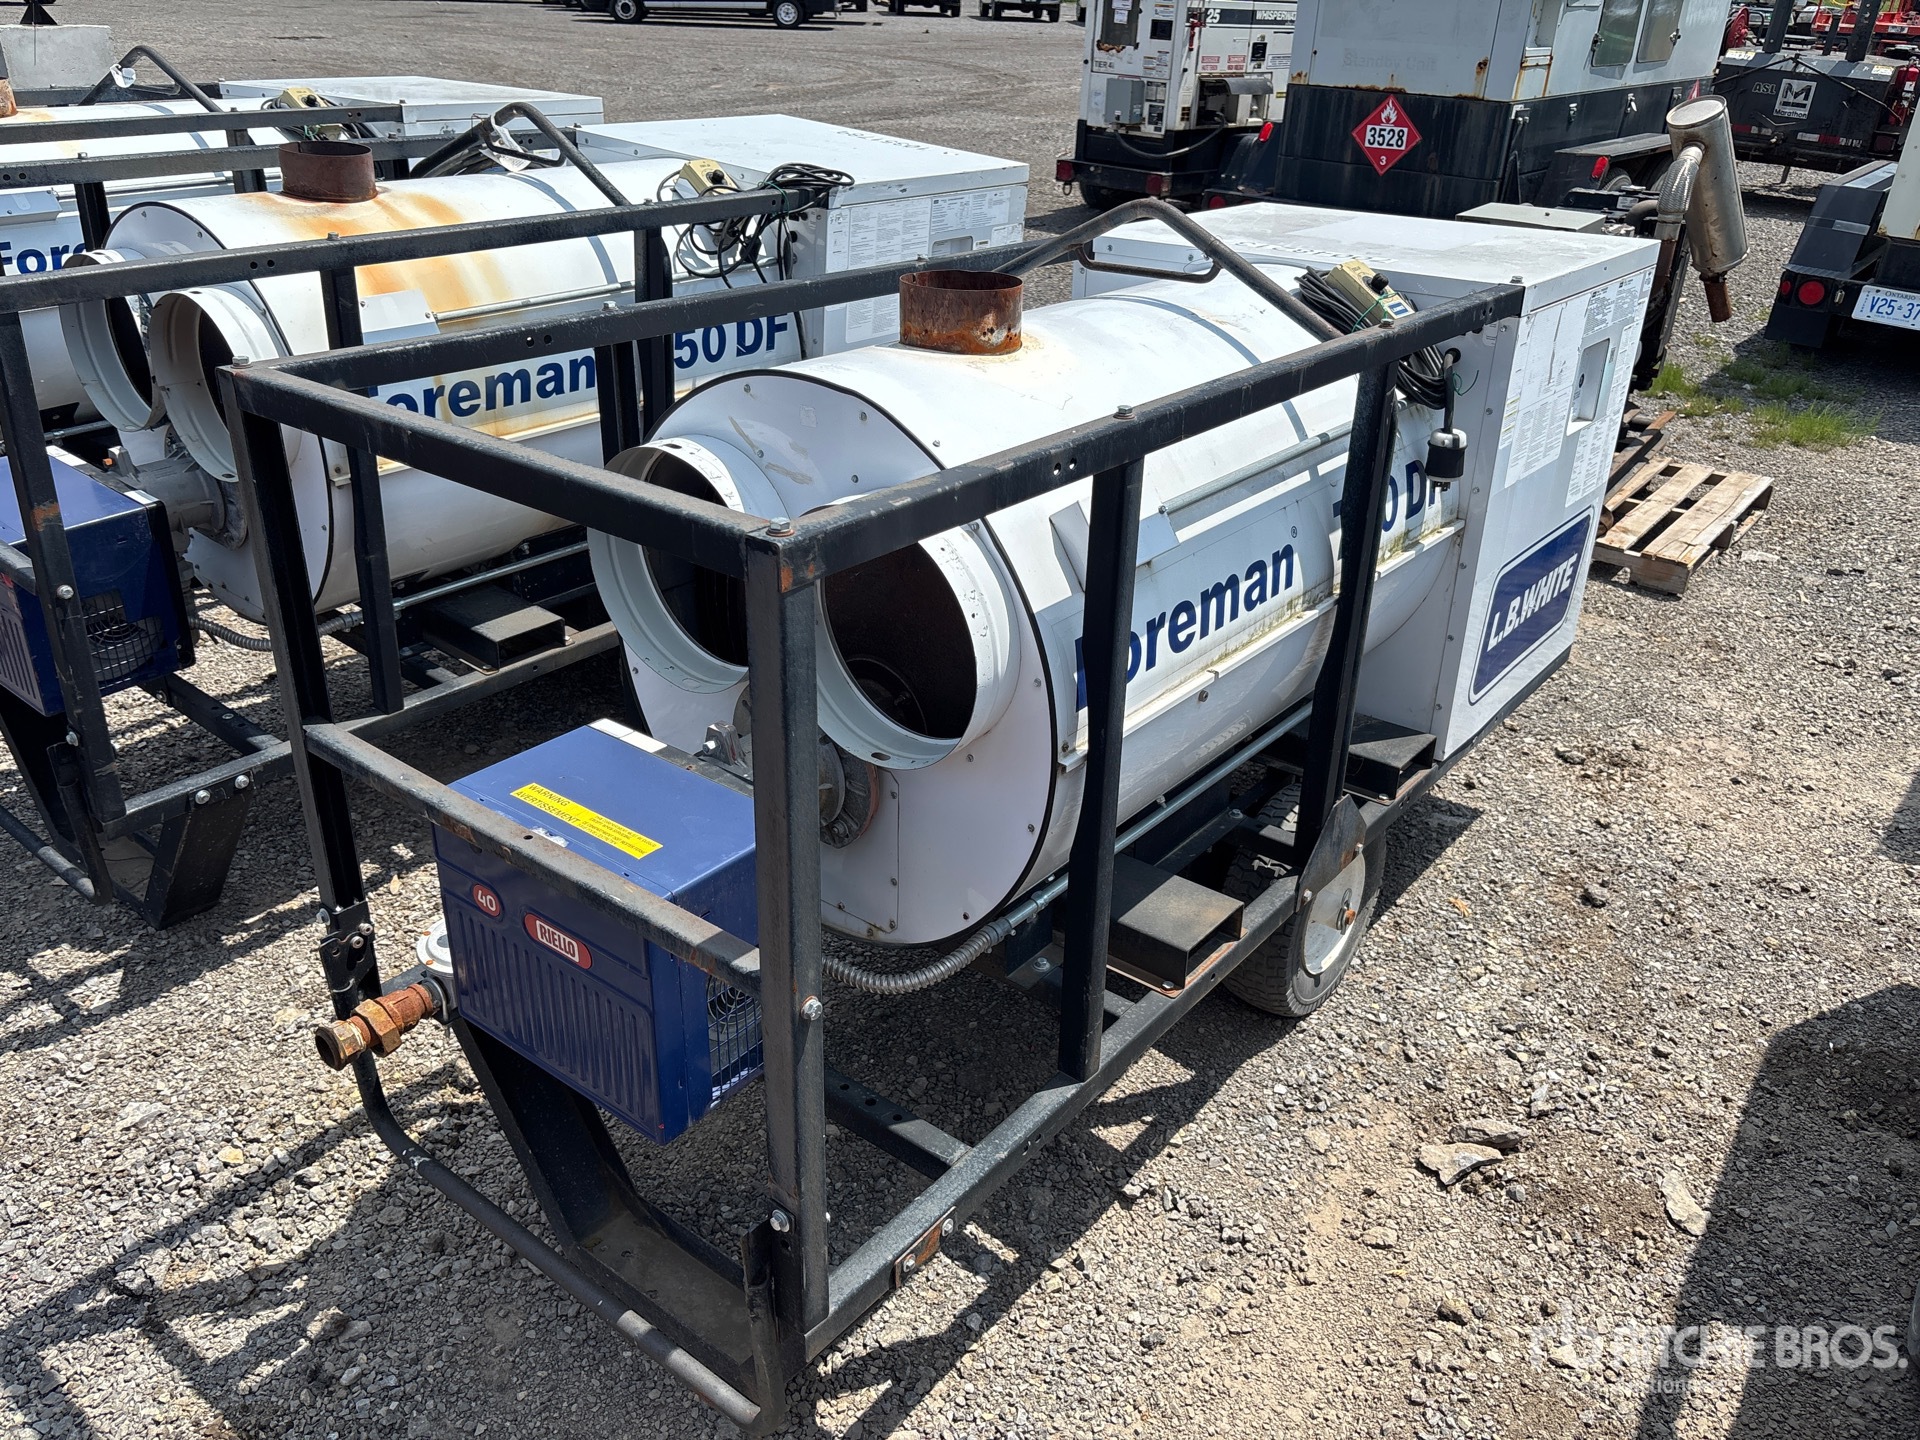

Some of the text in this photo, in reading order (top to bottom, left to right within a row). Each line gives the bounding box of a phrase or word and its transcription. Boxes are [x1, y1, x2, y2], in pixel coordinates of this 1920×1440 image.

[1206, 8, 1221, 23] 25
[1752, 82, 1776, 94] ASL
[1774, 108, 1807, 118] Marathon
[1367, 127, 1405, 148] 3528
[1380, 156, 1387, 165] 3
[1869, 296, 1898, 316] V25
[1885, 290, 1916, 300] ONTARIO
[736, 313, 788, 357] DF
[369, 351, 597, 420] reman
[1075, 543, 1293, 712] reman
[528, 784, 571, 807] WARNING
[515, 790, 581, 824] AVERTISSEMENT
[478, 889, 497, 912] 40
[539, 923, 576, 959] RIELLO
